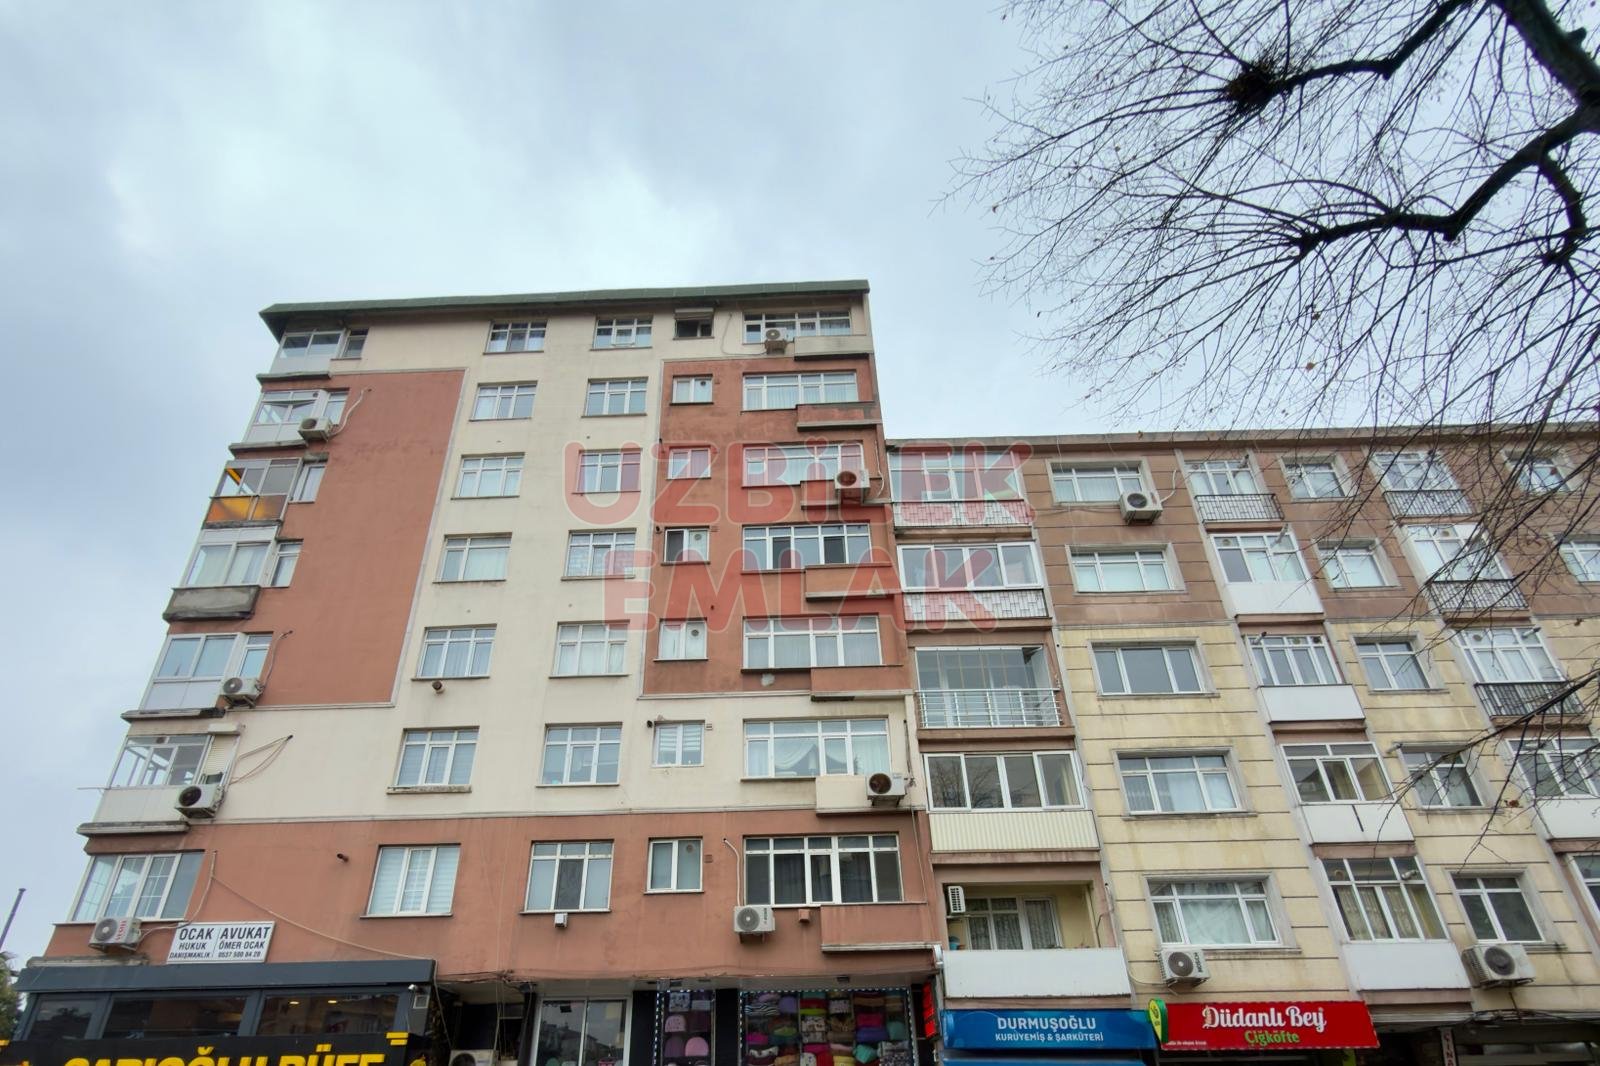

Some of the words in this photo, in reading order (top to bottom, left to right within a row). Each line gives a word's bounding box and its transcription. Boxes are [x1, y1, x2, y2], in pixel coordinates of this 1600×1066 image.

[179, 927, 215, 941] OCAK
[220, 926, 271, 940] AVUKAT
[178, 942, 207, 951] HUKUK
[218, 940, 242, 950] ÖMER
[243, 940, 265, 950] OCAK
[997, 1015, 1096, 1033] DURMUŞOĞLU
[1285, 1005, 1327, 1033] Bey
[1047, 1033, 1054, 1041] &
[1055, 1032, 1104, 1042] ŞARKÜTERİ
[1244, 1030, 1300, 1047] Çiğköfte
